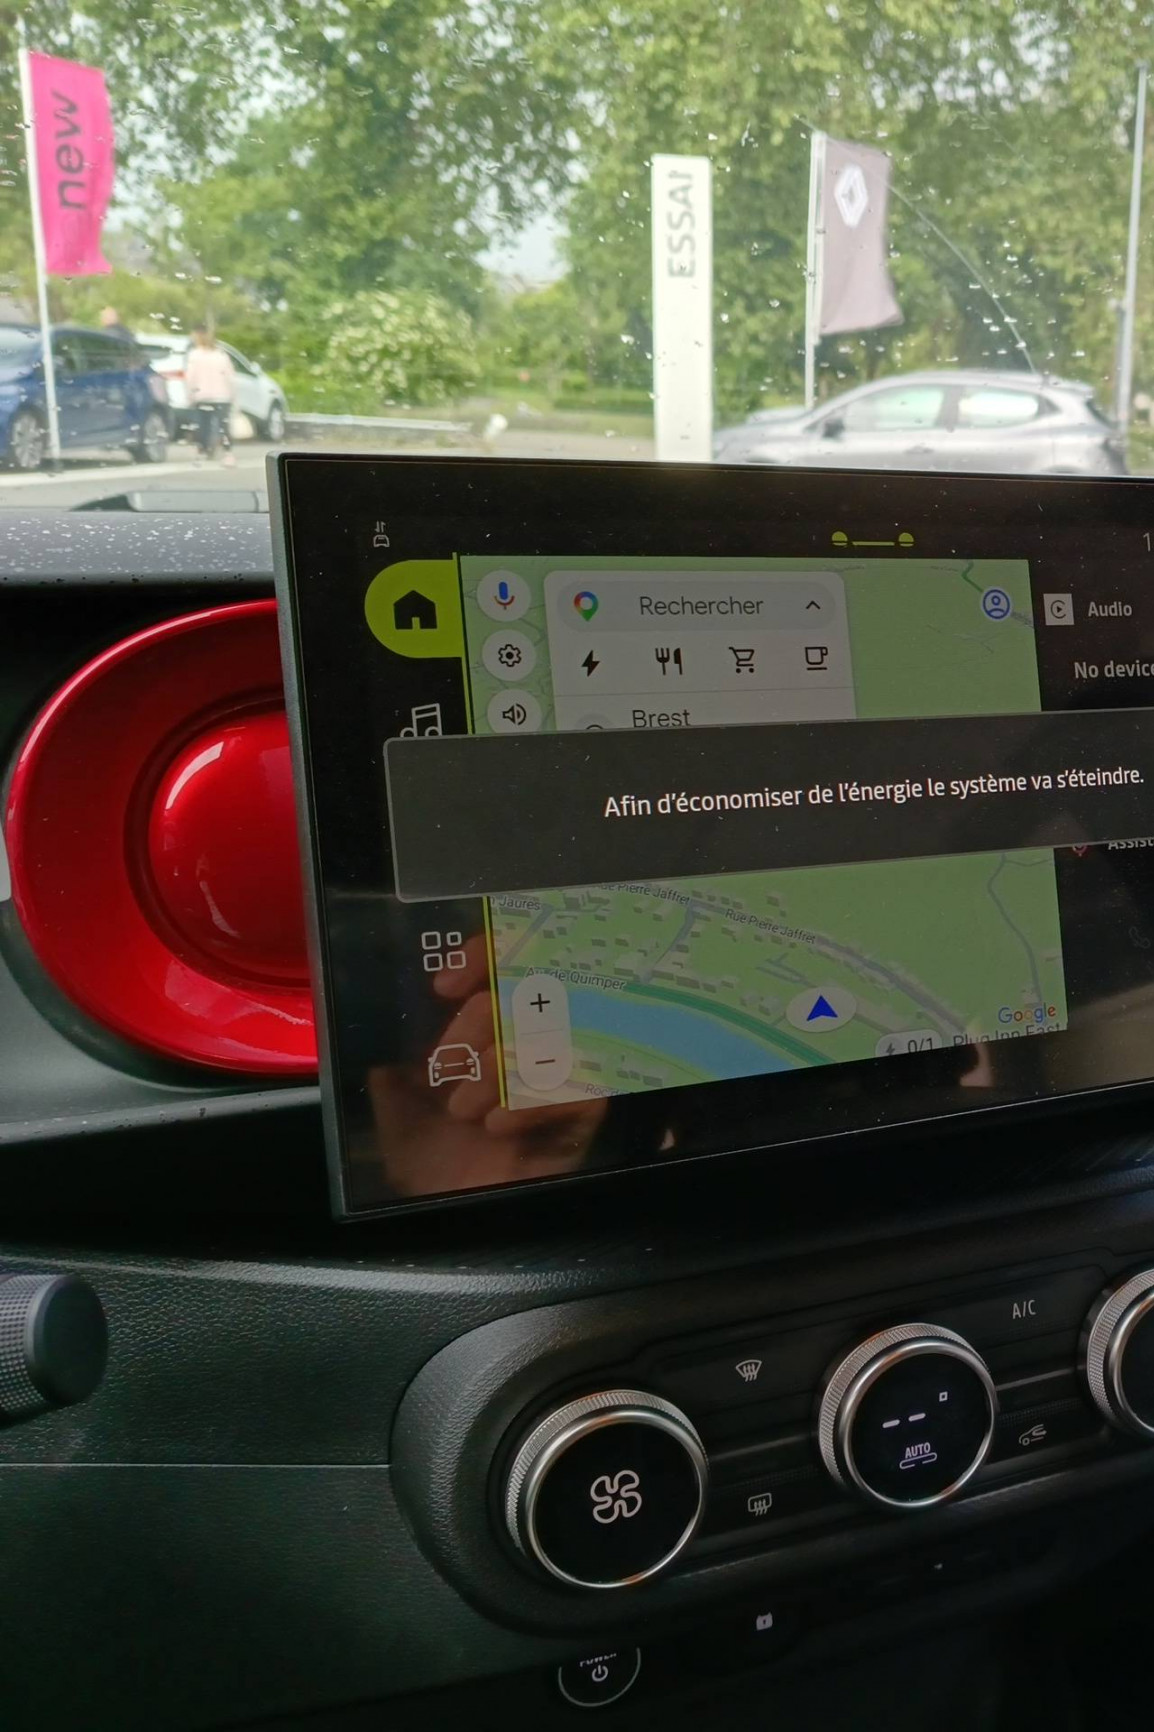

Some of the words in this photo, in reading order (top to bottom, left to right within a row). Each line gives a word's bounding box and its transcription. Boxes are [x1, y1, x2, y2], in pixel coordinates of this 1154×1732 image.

[52, 90, 87, 211] new
[667, 171, 696, 278] ESSAI
[639, 596, 764, 616] Rechercher
[1087, 601, 1133, 617] Audio
[1074, 662, 1099, 679] No
[632, 709, 691, 729] Brest
[604, 795, 651, 818] Afin
[657, 790, 803, 815] d'économiser
[808, 784, 833, 804] de
[838, 778, 923, 804] l'énergie
[928, 778, 945, 797] le
[950, 773, 1027, 799] système
[1031, 774, 1052, 790] va
[1057, 766, 1145, 789] s'éteindre.
[725, 908, 746, 924] Rue
[748, 915, 779, 933] Pierre
[780, 926, 816, 944] Jaffret
[570, 970, 626, 990] Quimper
[998, 1003, 1057, 1024] Google
[907, 1037, 934, 1054] 0/1
[1012, 1299, 1037, 1320] A/C
[904, 1442, 931, 1460] AUTO
